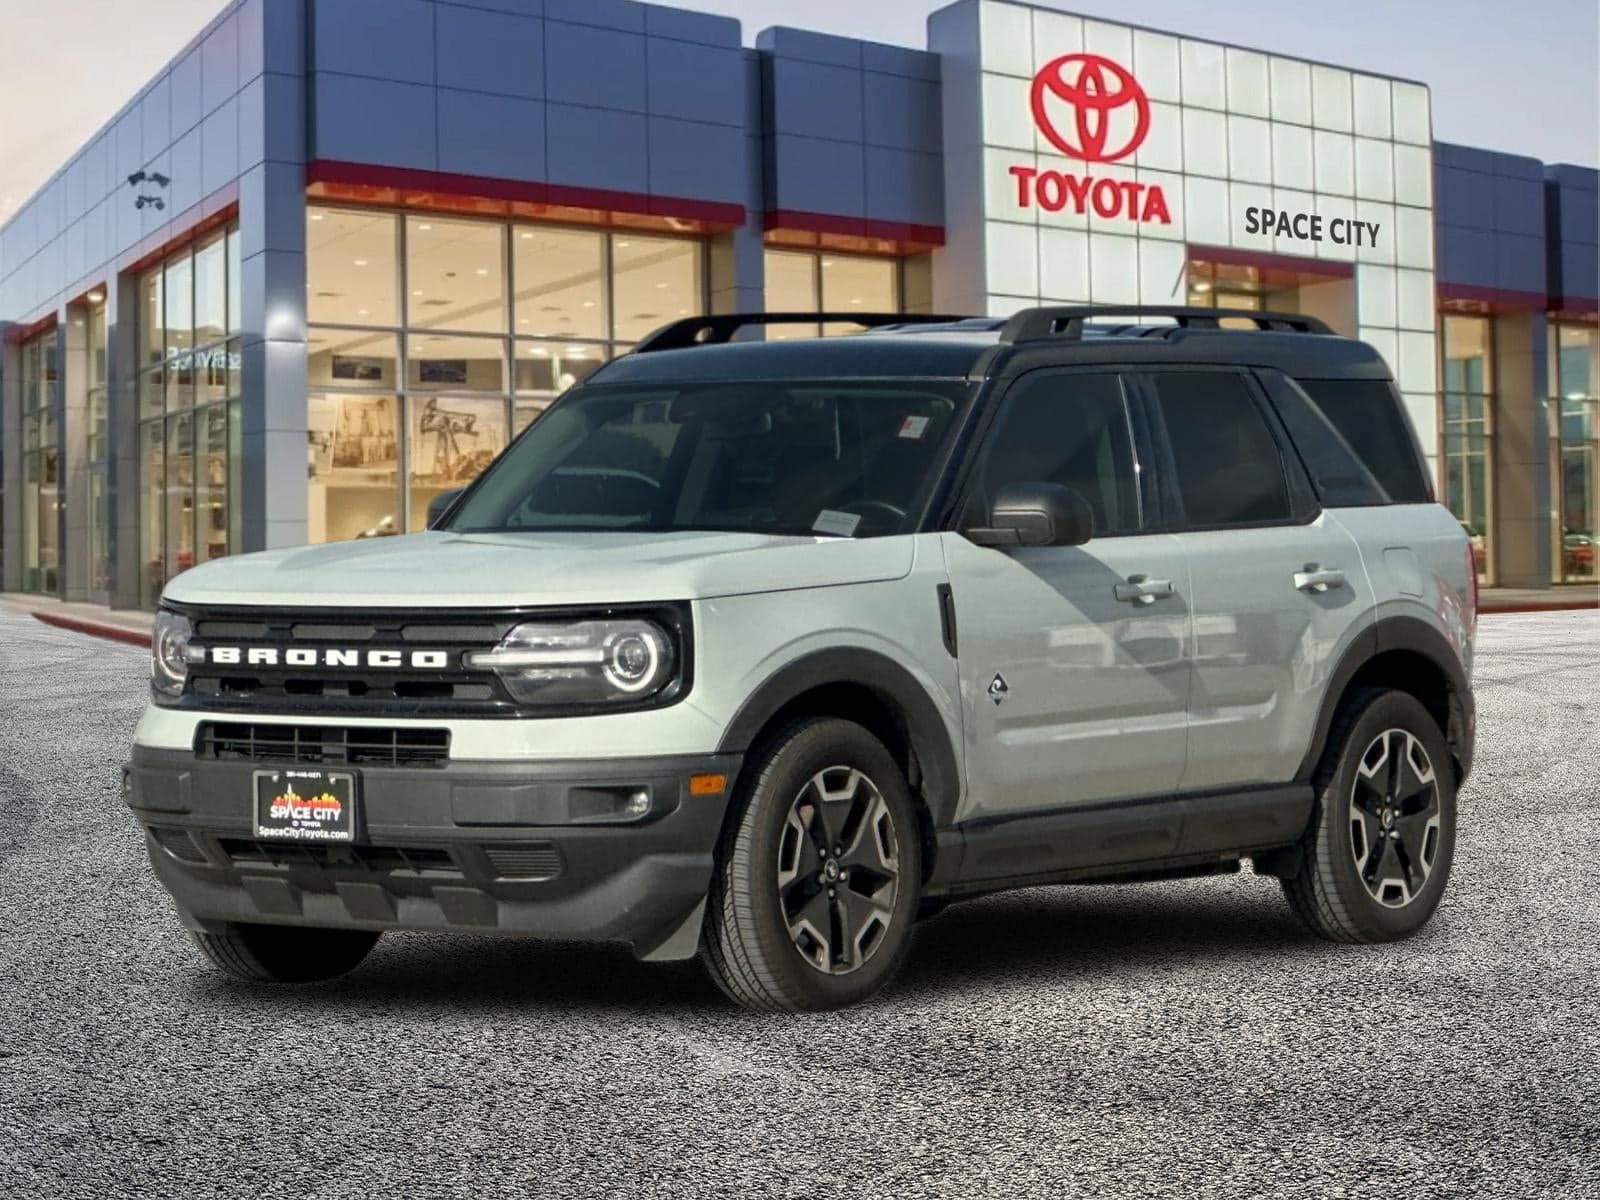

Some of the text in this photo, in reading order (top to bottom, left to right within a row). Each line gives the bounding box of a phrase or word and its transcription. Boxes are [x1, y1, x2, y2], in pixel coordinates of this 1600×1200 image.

[1009, 166, 1171, 224] TOYOTA
[1245, 206, 1381, 247] SPACE CITY
[212, 647, 447, 668] BRONCO
[270, 805, 341, 821] SPACE CITY
[259, 826, 348, 839] SpaceCityToyota.com
